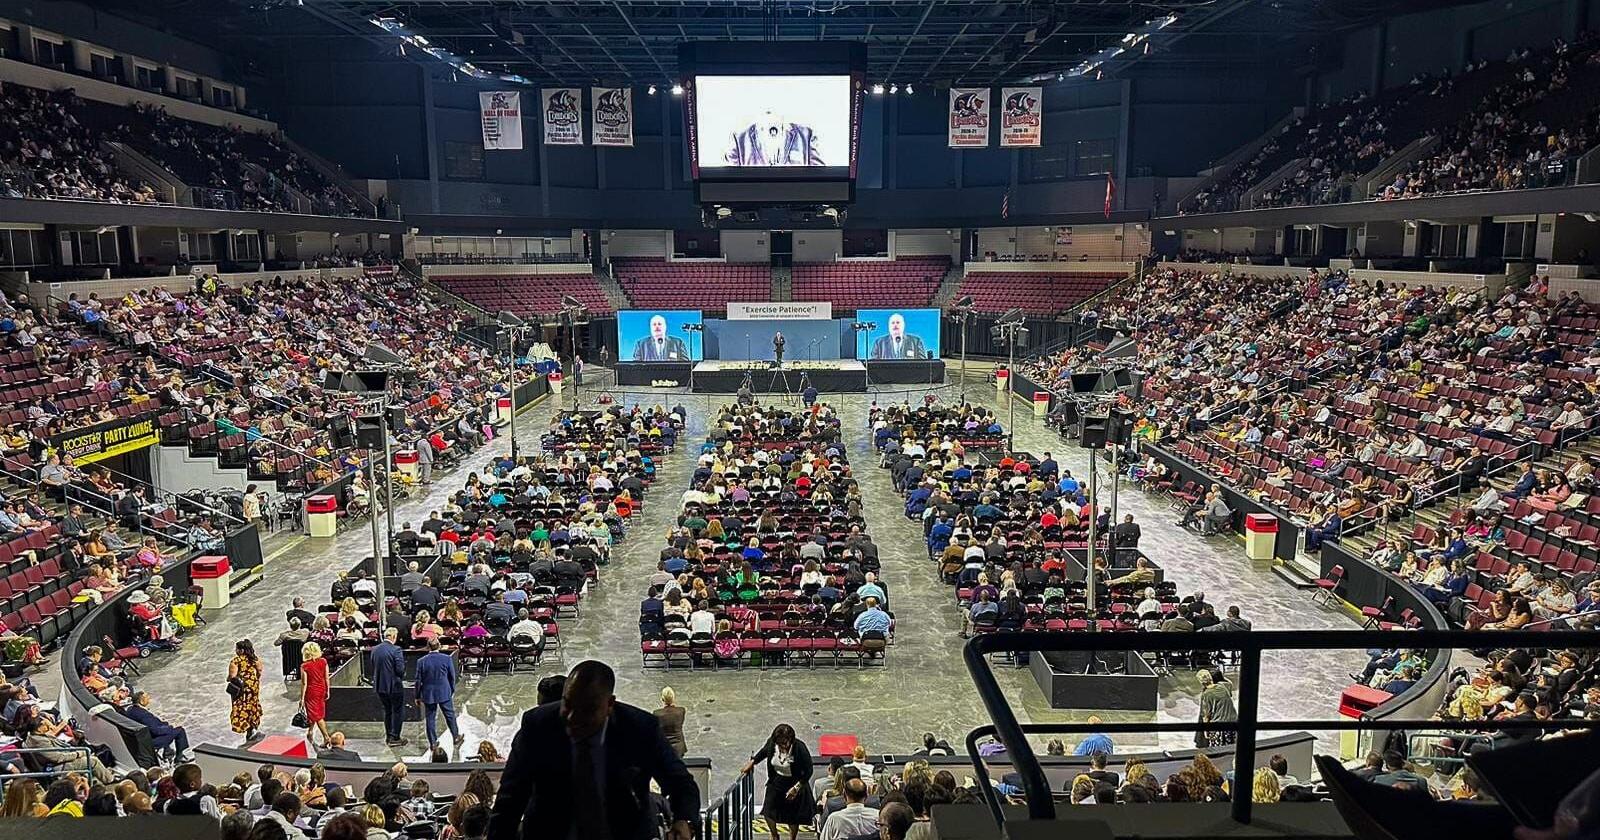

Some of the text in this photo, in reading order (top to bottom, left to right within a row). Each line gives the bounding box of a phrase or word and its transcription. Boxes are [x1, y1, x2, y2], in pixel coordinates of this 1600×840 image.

[742, 306, 777, 314] "Exercise
[104, 426, 127, 445] PARTY
[128, 419, 153, 438] LOUNGE
